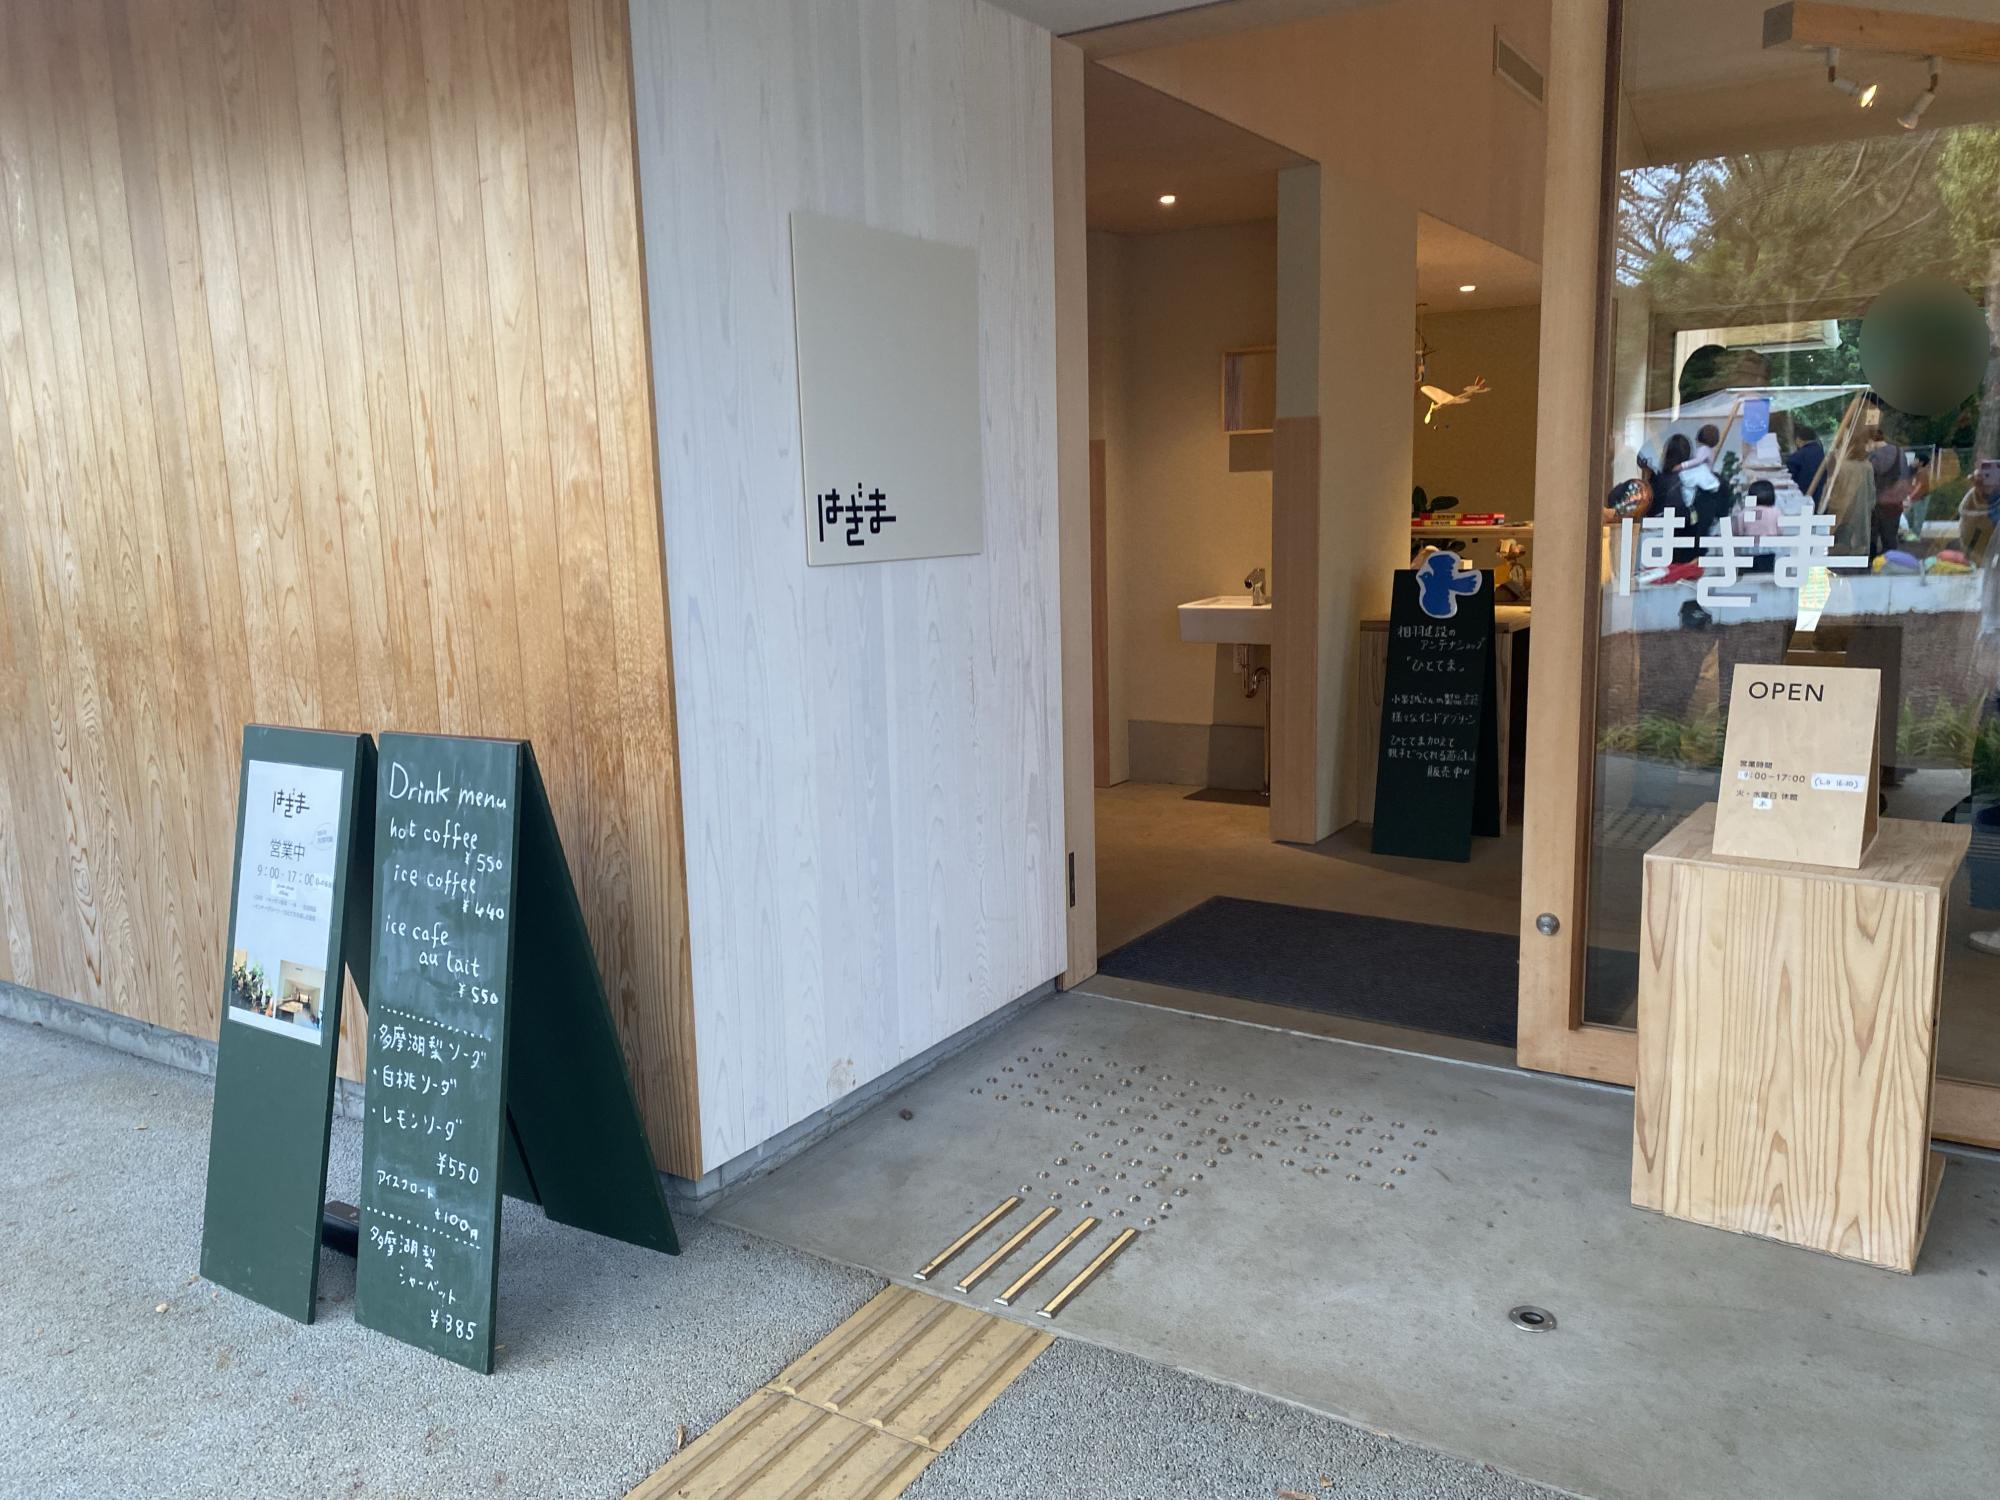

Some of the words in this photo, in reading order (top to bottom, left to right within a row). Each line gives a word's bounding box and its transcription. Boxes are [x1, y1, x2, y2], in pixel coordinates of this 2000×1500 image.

[1420, 637, 1486, 651] アンテナショップ
[1748, 681, 1824, 702] OPEN
[389, 761, 450, 805] Drink
[458, 787, 507, 810] menu
[270, 838, 305, 862] 営業中
[390, 817, 416, 839] hot
[424, 819, 478, 850] coffee
[394, 864, 418, 887] ice
[427, 869, 476, 899] coffee
[385, 915, 406, 936] ice
[412, 922, 449, 948] cafe
[420, 951, 439, 966] au
[447, 950, 480, 978] lait
[376, 1169, 435, 1199] アイスフロート
[436, 1151, 479, 1184] ¥550
[369, 1225, 436, 1270] 多摩湖梨
[399, 1265, 456, 1304] シャーベット
[430, 1308, 477, 1341] ¥385
